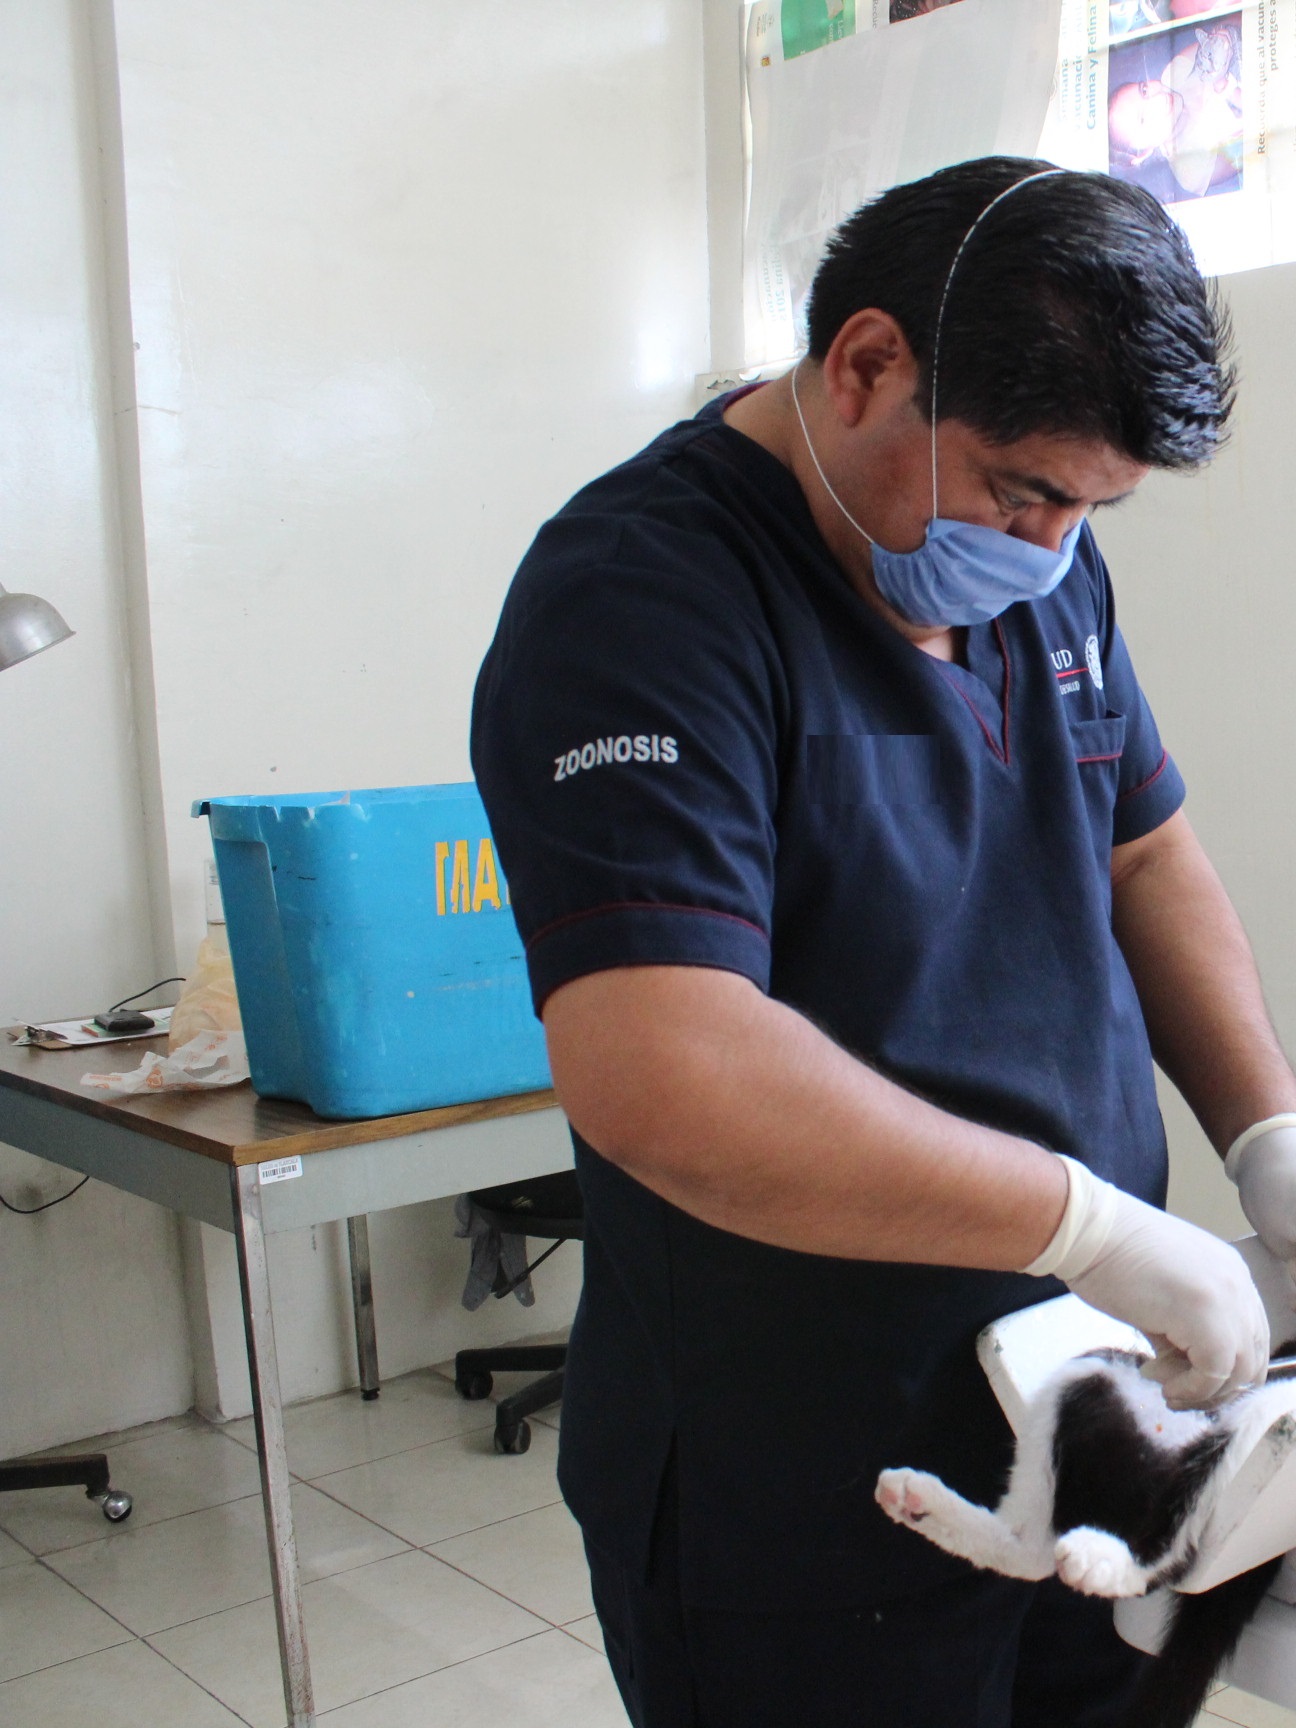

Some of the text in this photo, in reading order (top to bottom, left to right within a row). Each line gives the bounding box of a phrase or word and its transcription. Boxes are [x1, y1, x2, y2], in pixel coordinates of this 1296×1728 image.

[1086, 4, 1099, 130] Canina y Felina
[1256, 46, 1265, 58] al
[1268, 9, 1279, 71] proteges
[1257, 62, 1268, 87] que
[1256, 90, 1266, 155] Recuerda
[554, 734, 679, 782] ZOONOSIS
[435, 838, 512, 916] MA
